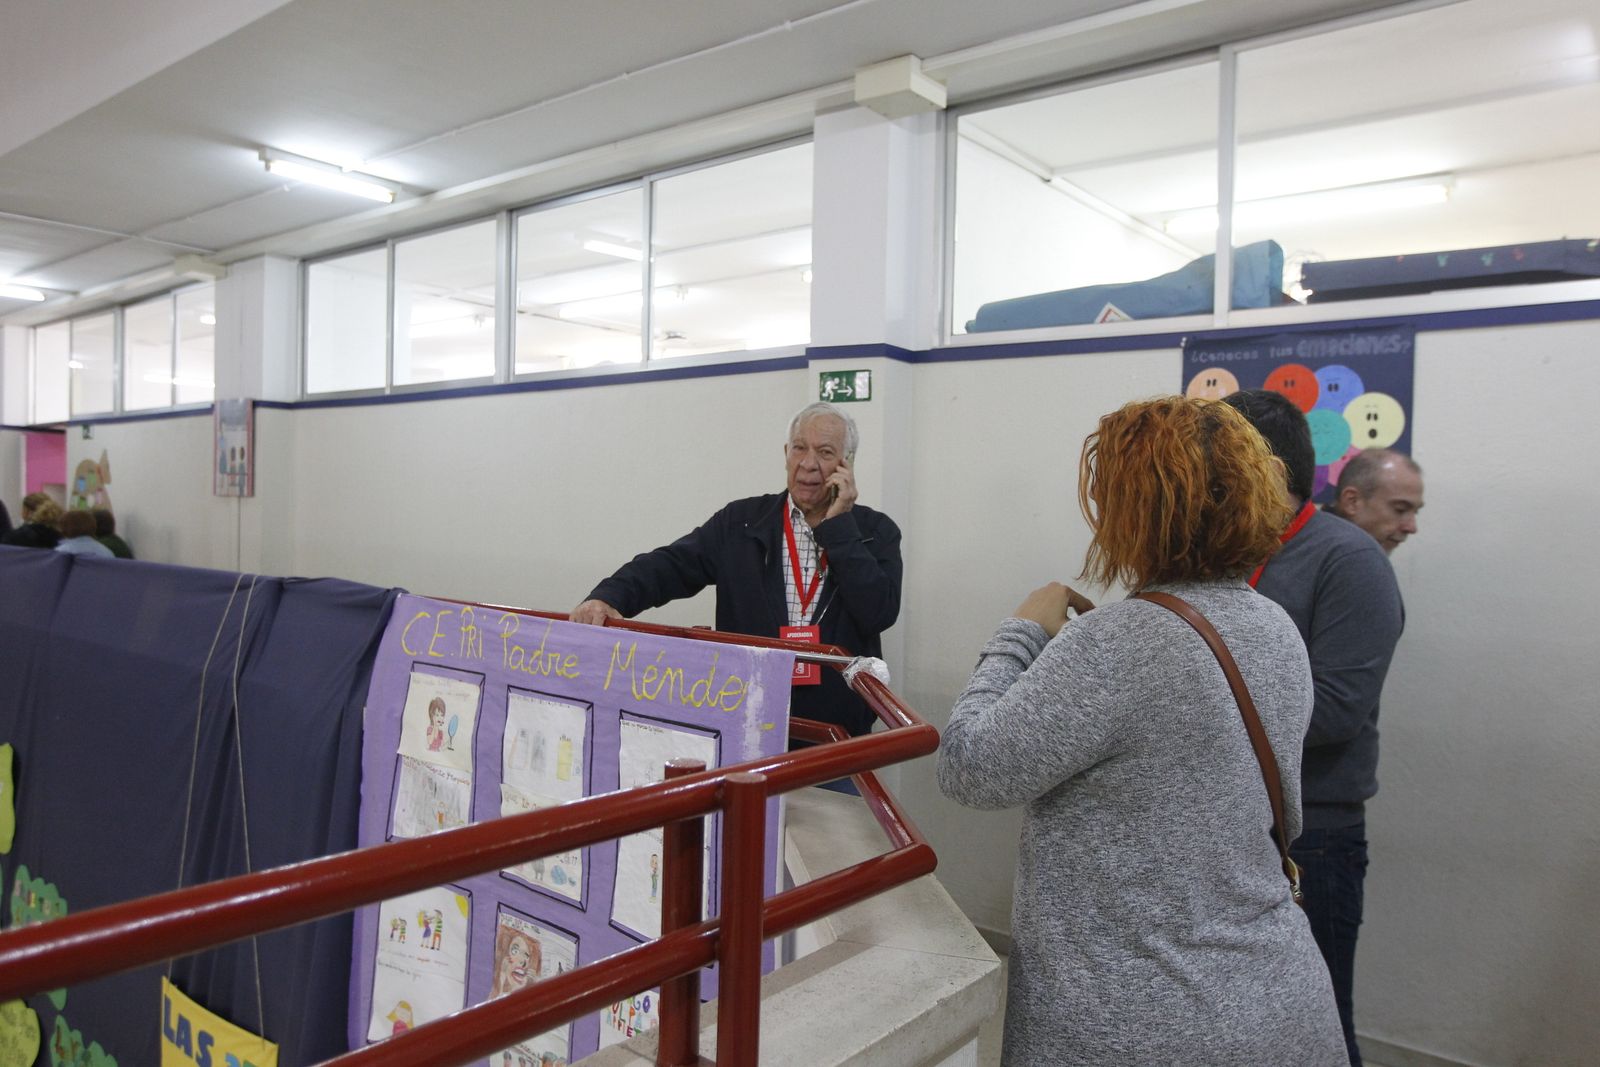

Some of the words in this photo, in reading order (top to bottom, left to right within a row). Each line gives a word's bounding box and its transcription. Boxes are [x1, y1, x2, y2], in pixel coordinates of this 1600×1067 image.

[1269, 346, 1294, 359] tus
[499, 612, 580, 678] Padre
[603, 640, 776, 730] Ménde
[163, 993, 215, 1067] LAS
